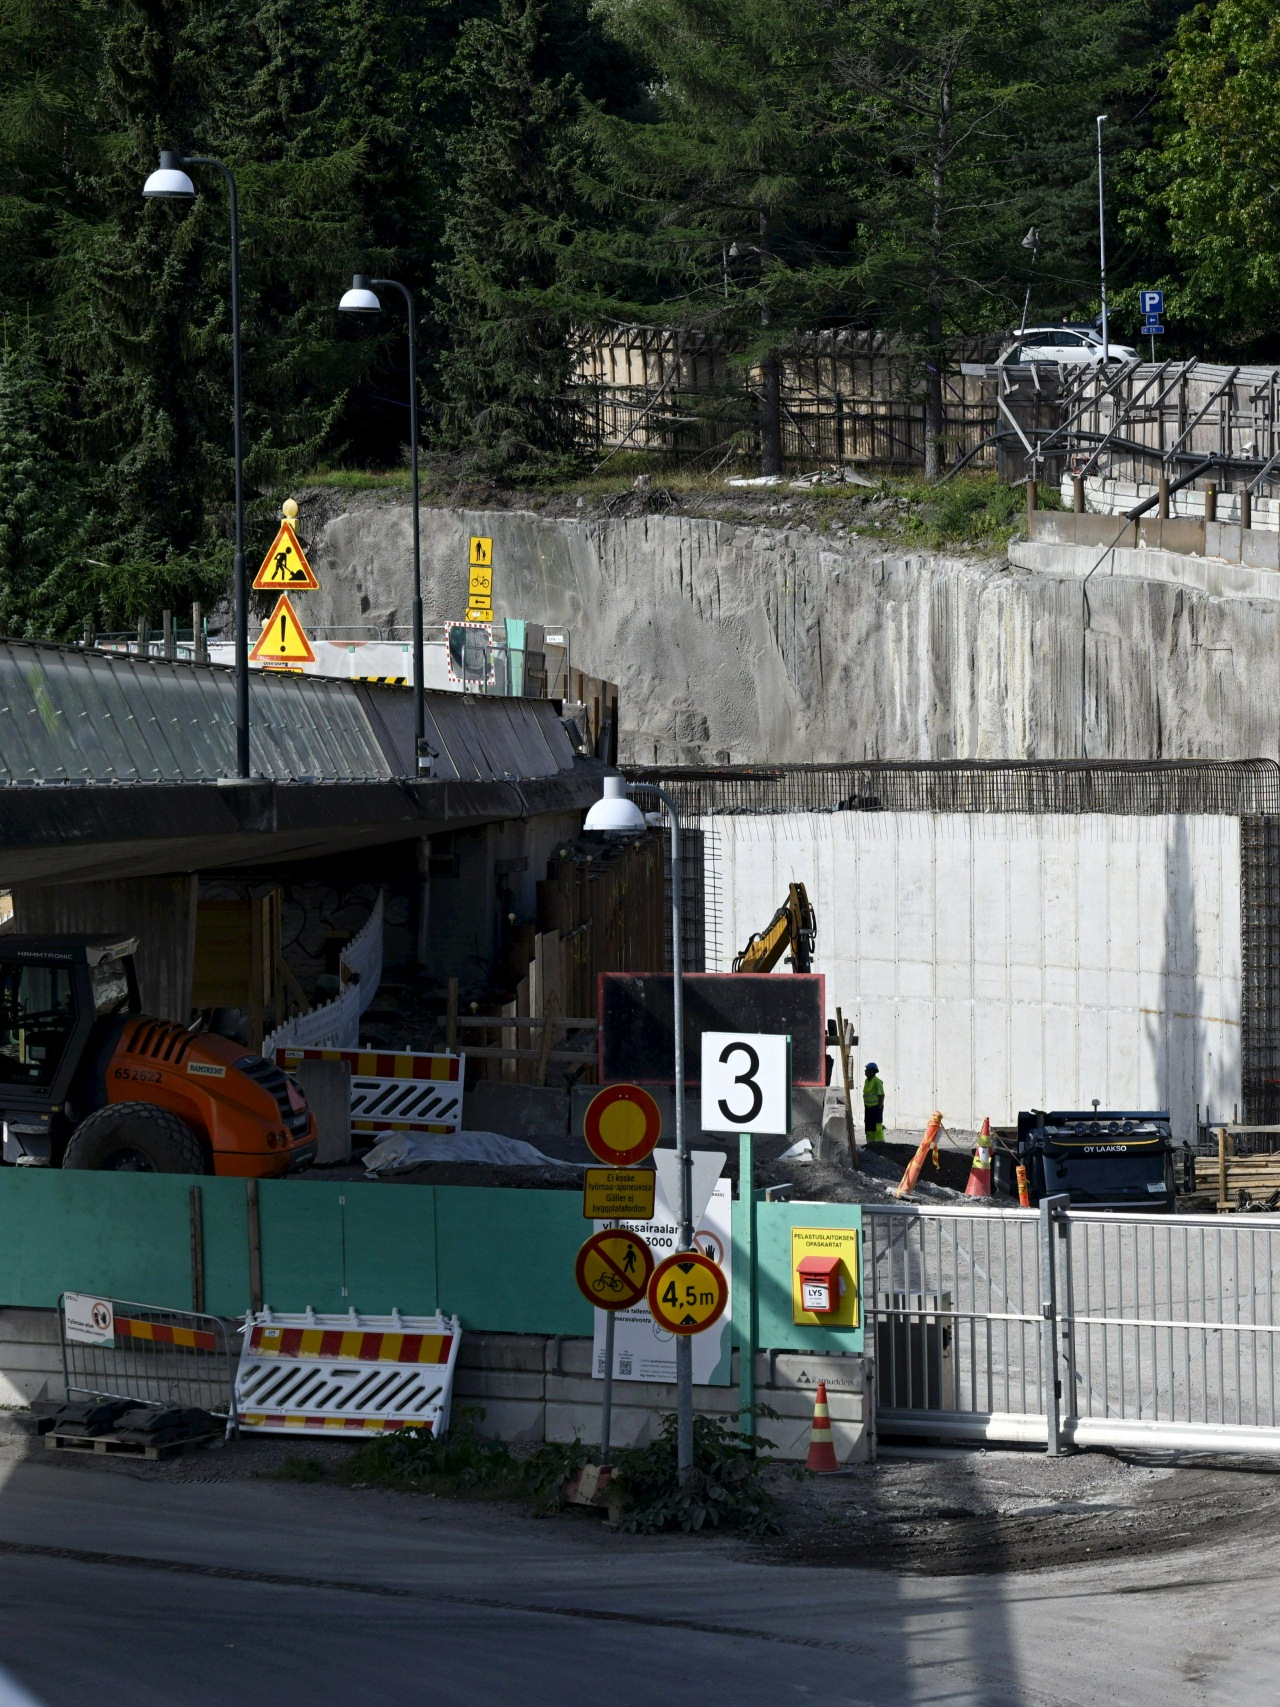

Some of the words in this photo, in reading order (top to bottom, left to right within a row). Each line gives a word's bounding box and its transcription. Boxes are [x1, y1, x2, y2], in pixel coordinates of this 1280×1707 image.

[1145, 293, 1159, 312] P
[17, 951, 73, 959] HAMMTRONIC
[190, 1064, 223, 1075] RAMIRENT
[114, 1067, 162, 1083] 652622
[718, 1041, 763, 1124] 3
[1096, 1145, 1127, 1153] LAAKSO
[607, 1173, 614, 1182] Ei
[616, 1173, 635, 1182] koske
[588, 1182, 652, 1192] työmaa-ajoneuvoja
[605, 1194, 626, 1202] Gäller
[628, 1194, 634, 1202] ej
[592, 1204, 646, 1213] byggplatsfordon
[794, 1233, 854, 1241] PELASTUSLAITOKSEN
[808, 1289, 823, 1297] LYS
[67, 1318, 94, 1329] Työmaa-alue
[811, 1376, 853, 1386] Ramudden
